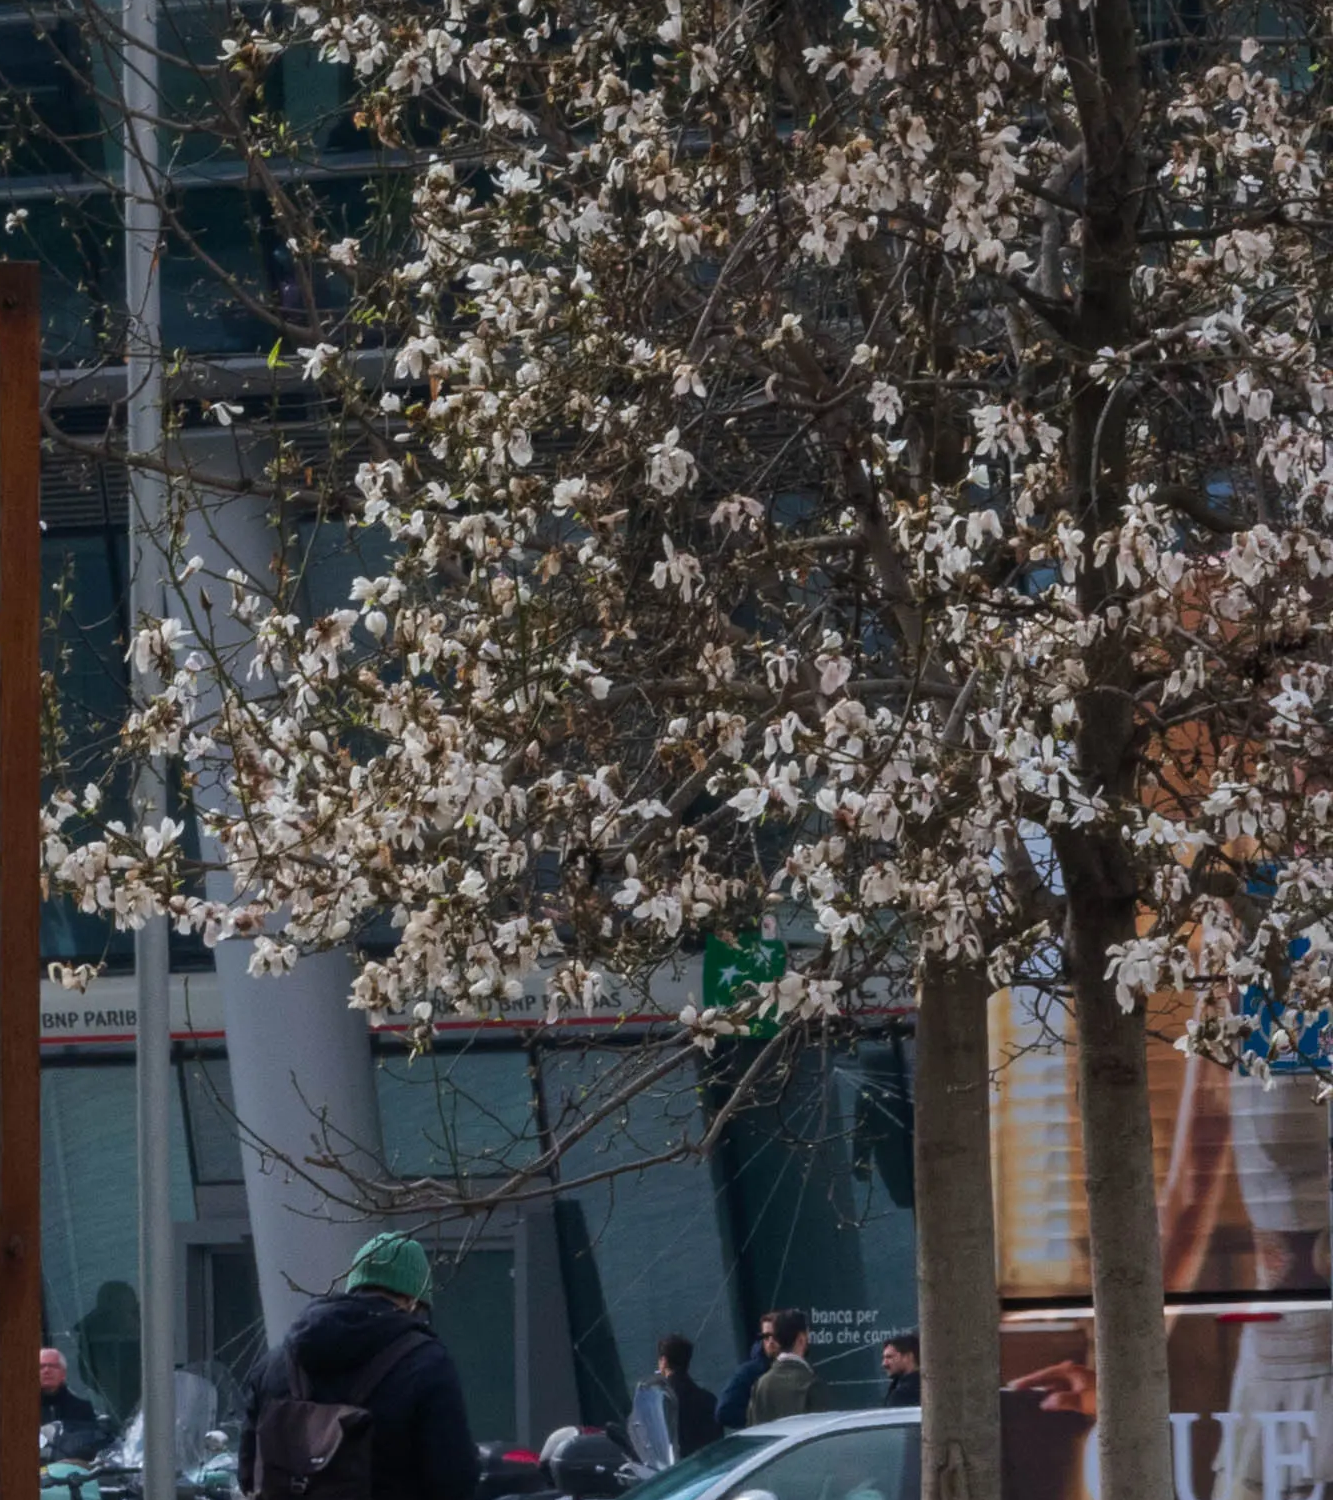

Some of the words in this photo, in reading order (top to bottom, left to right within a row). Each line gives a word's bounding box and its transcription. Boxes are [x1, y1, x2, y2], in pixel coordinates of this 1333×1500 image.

[42, 1012, 79, 1028] BNP
[84, 1010, 137, 1027] PARIB
[811, 1307, 853, 1324] banca
[856, 1309, 879, 1326] per
[807, 1327, 834, 1344] ndo
[836, 1326, 861, 1344] che
